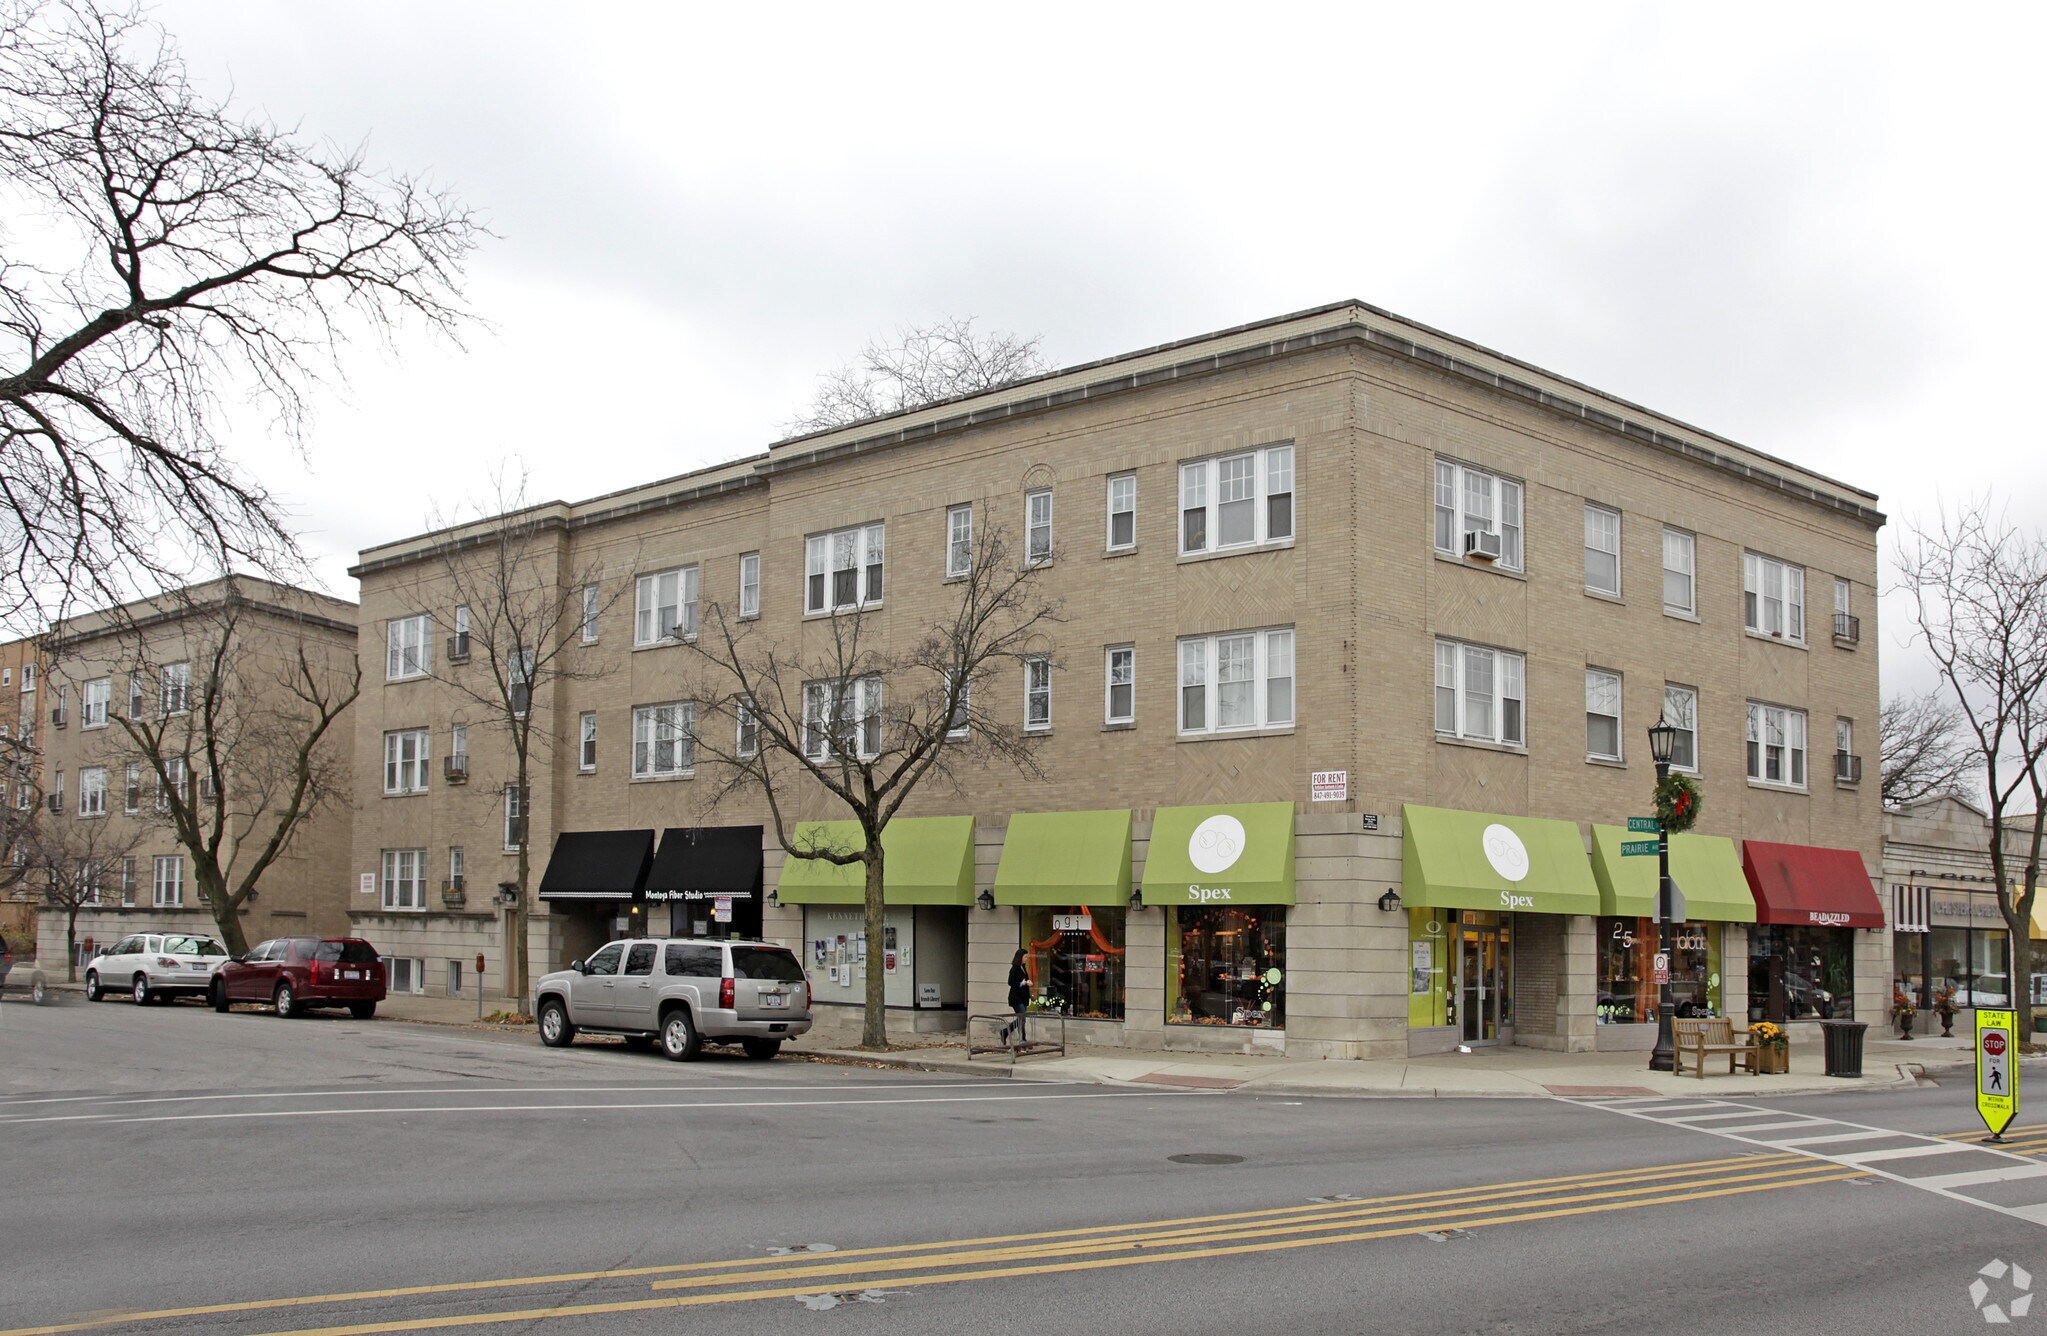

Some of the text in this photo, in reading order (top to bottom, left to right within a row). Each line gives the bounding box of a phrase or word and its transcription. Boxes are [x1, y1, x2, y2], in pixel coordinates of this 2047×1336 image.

[1313, 773, 1345, 784] FOR RENT
[1313, 791, 1345, 799] 847-491-9039
[1628, 819, 1655, 830] CENTRAL
[1621, 843, 1649, 854] PRAIRIE
[669, 890, 683, 899] Fiber
[684, 890, 703, 900] Studio
[1188, 884, 1231, 904] Spex
[1501, 891, 1533, 909] Spex
[827, 912, 865, 921] KENNETH
[1809, 911, 1850, 923] BEADAZZLED
[1235, 1006, 1266, 1021] Spex
[1984, 1040, 2005, 1049] STOP
